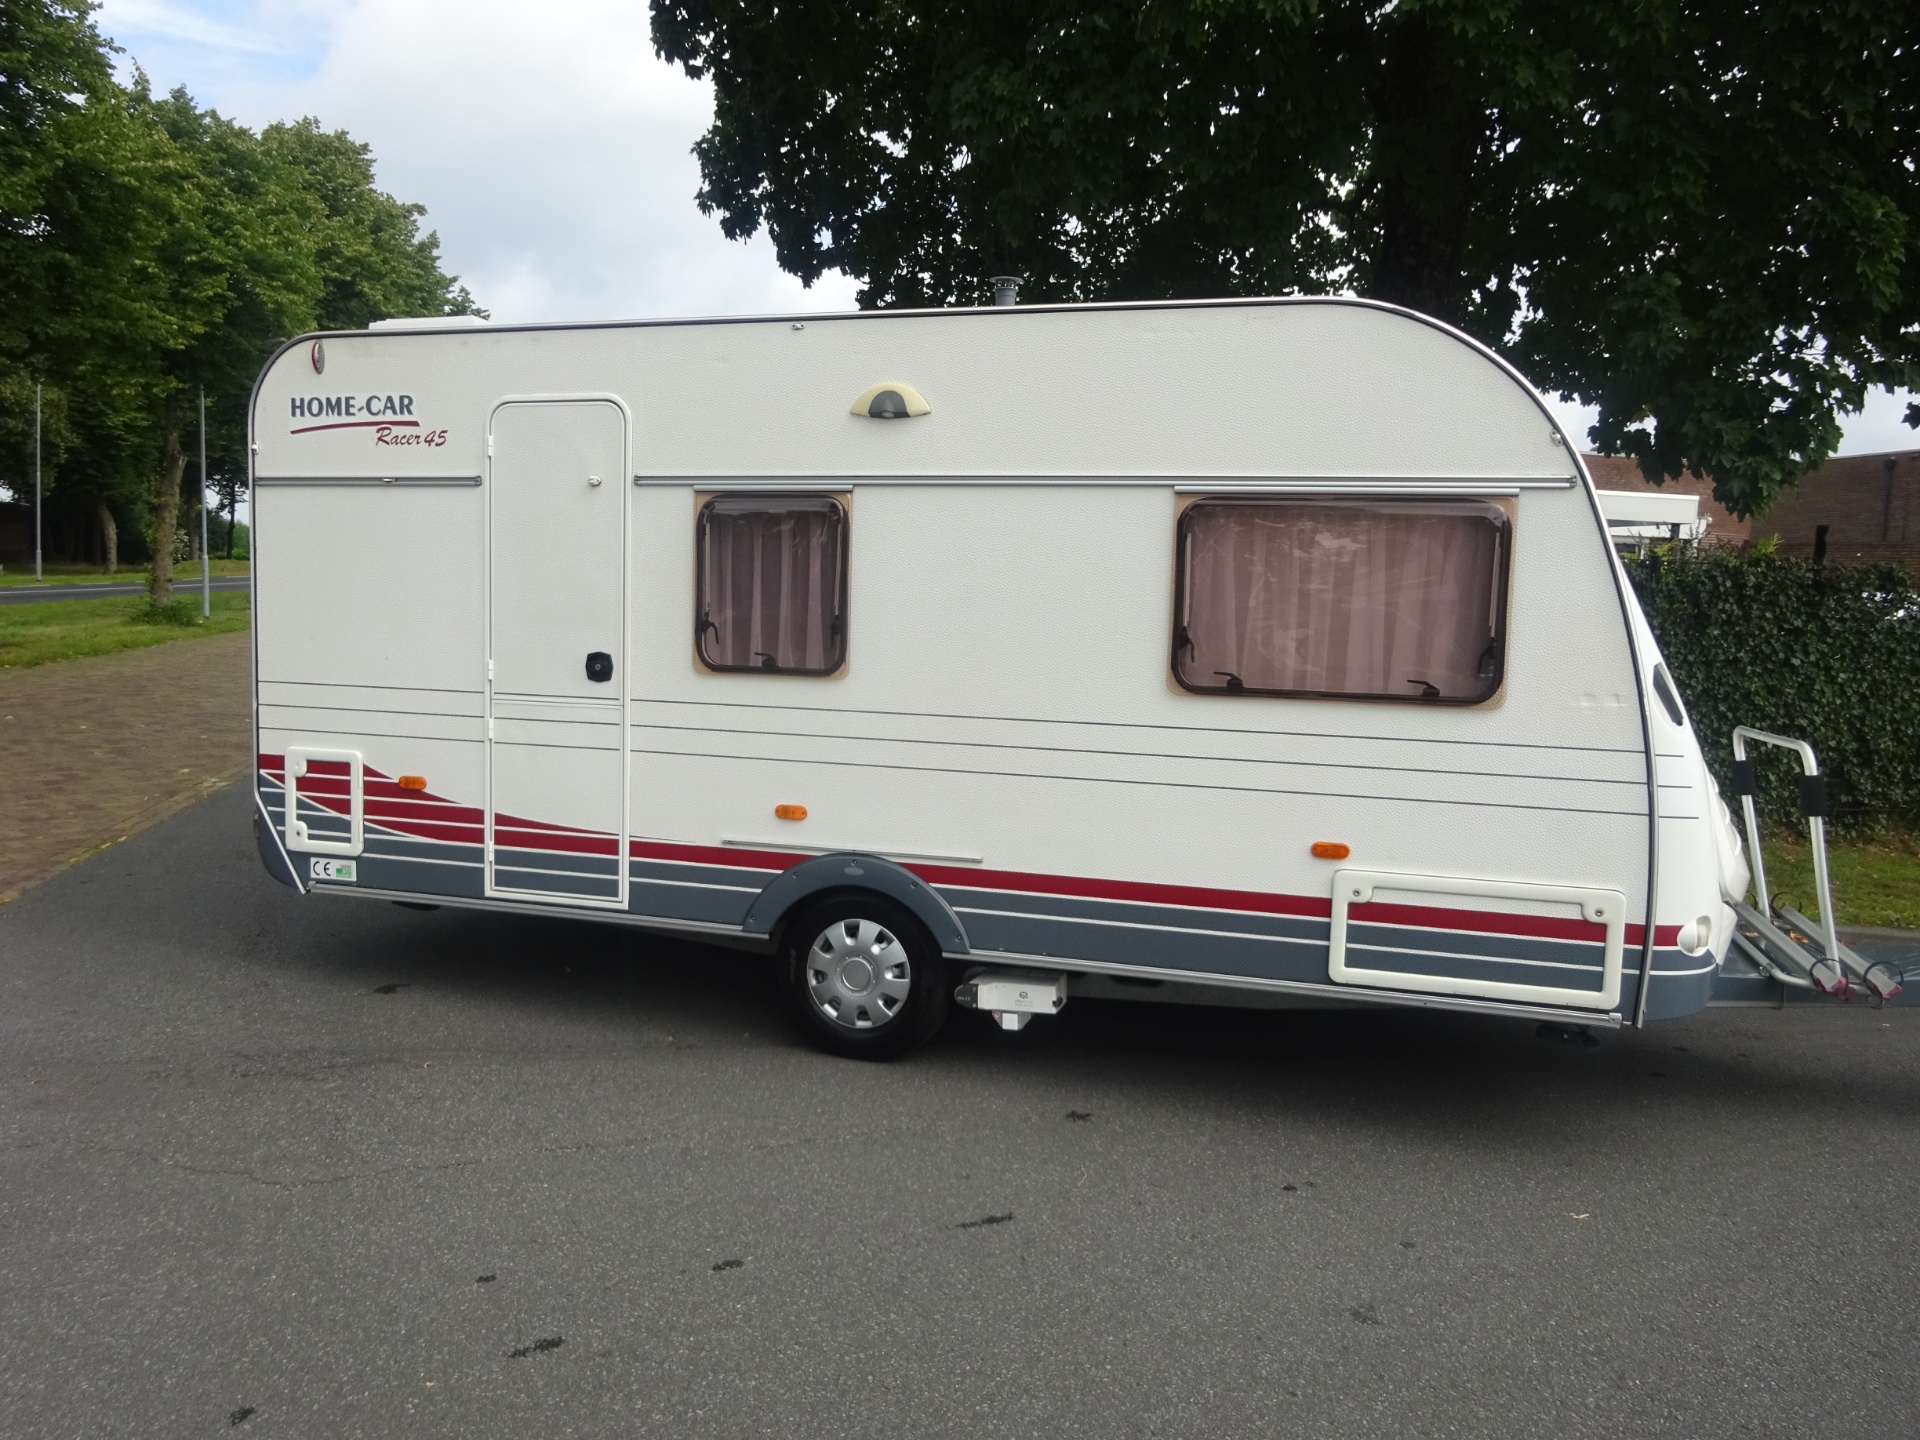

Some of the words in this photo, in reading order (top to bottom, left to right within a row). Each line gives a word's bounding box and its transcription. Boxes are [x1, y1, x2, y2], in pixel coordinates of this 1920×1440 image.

[290, 395, 414, 418] HOME-CAR
[375, 426, 422, 446] Racer
[423, 429, 449, 447] 45
